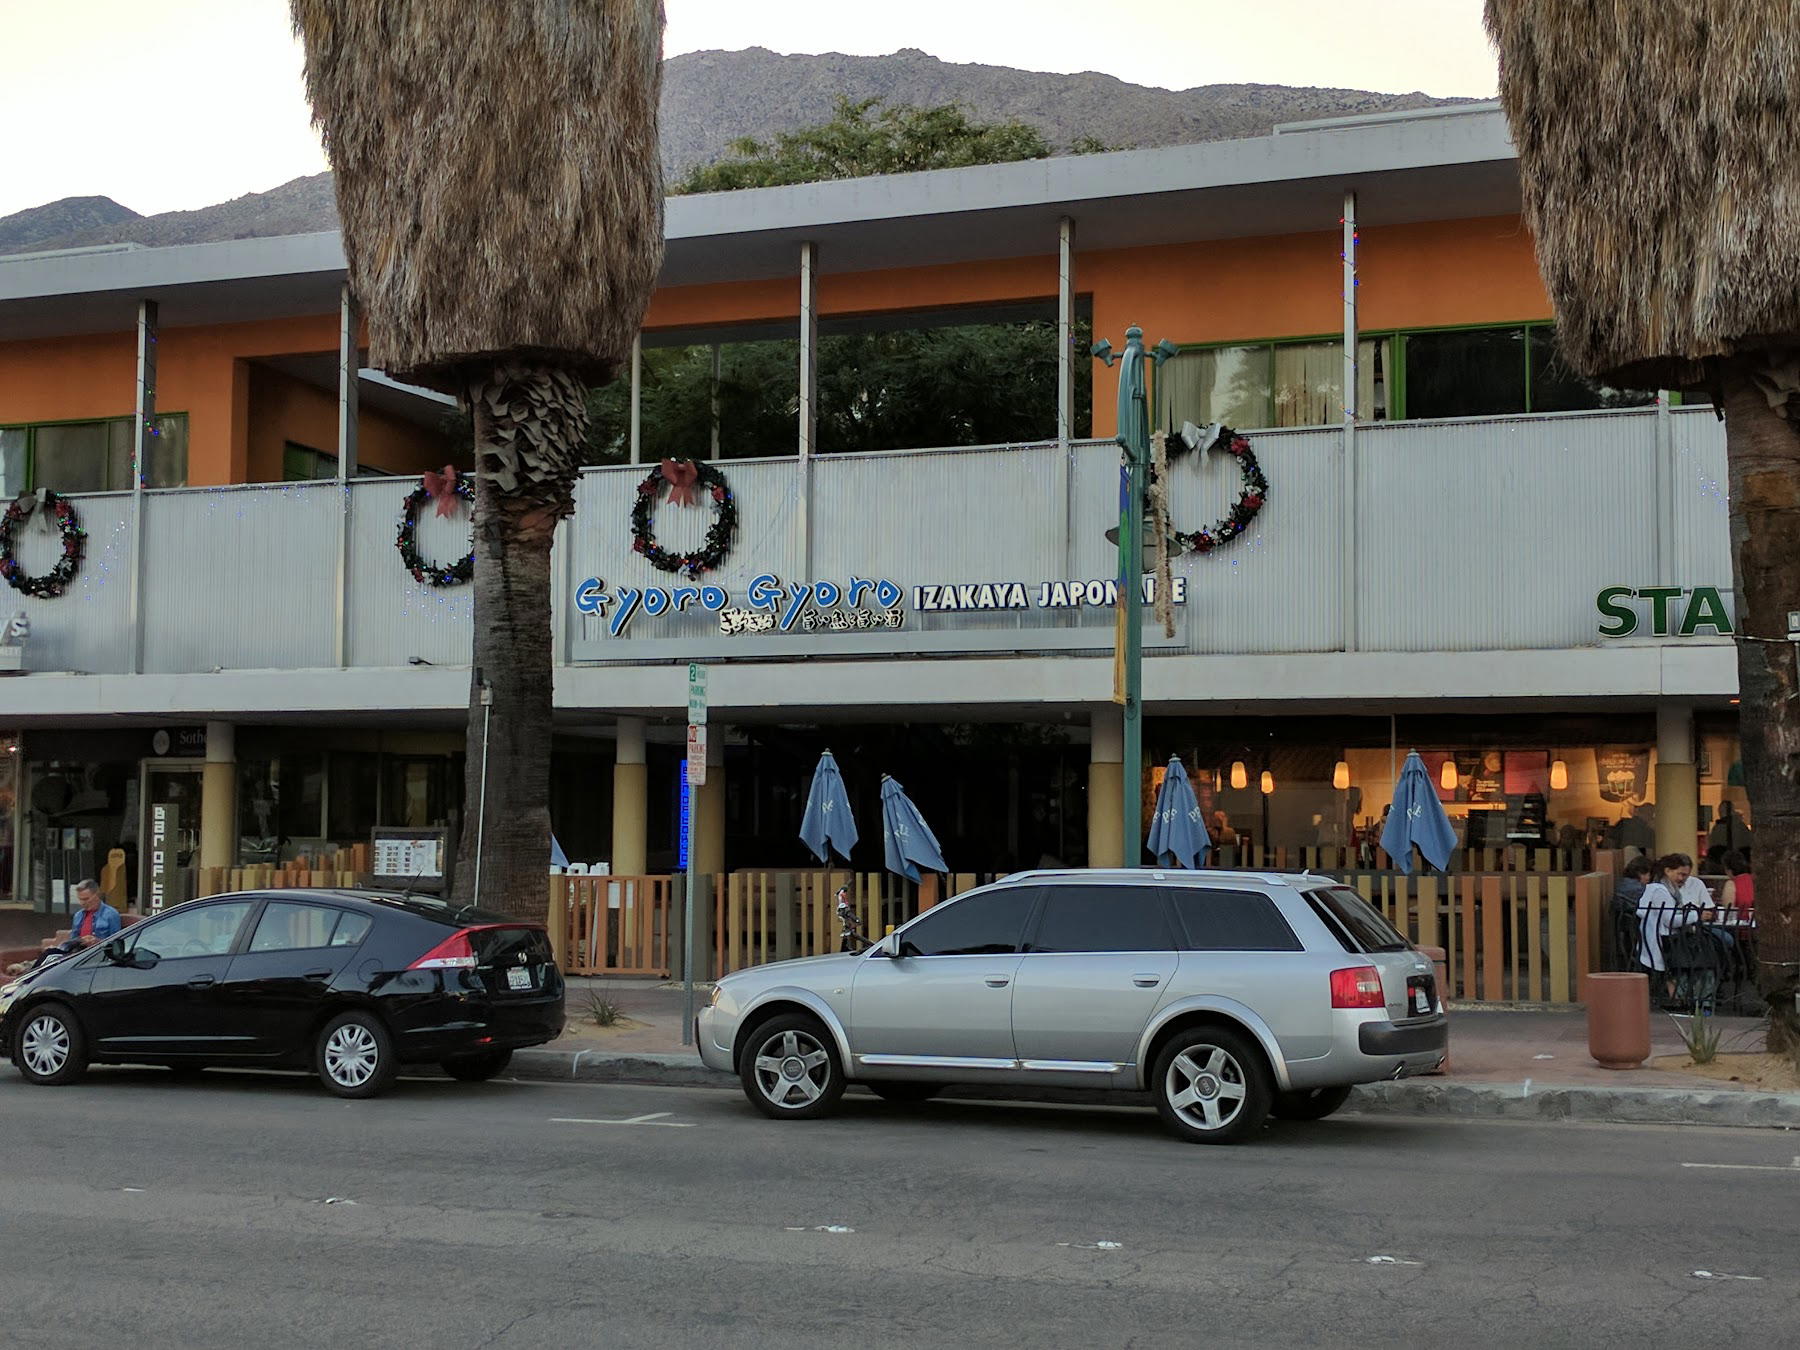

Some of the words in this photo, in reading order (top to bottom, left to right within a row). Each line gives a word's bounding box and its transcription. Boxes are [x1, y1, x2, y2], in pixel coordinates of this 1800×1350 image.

[575, 576, 729, 636] Gyoro
[748, 573, 904, 632] Gyoro
[912, 582, 1029, 611] IZAKAYA
[1038, 577, 1187, 608] JAPONIE
[1596, 585, 1736, 638] STA
